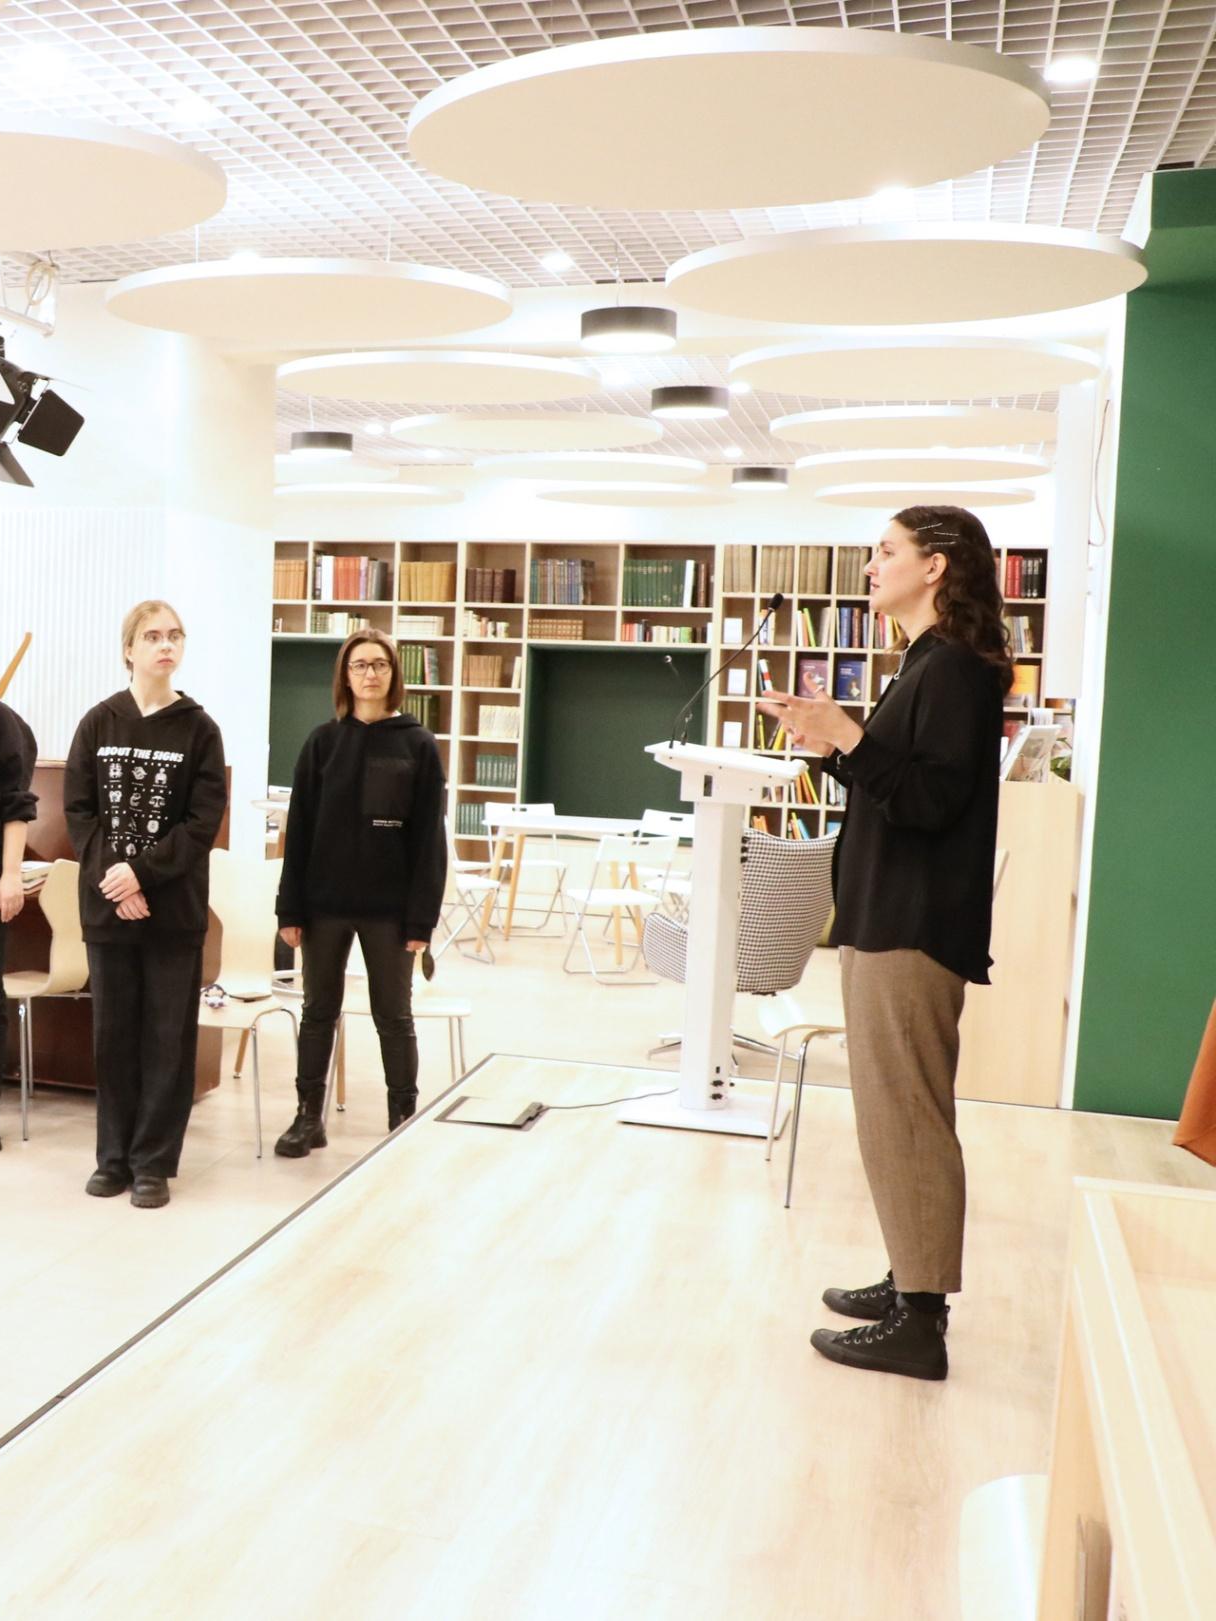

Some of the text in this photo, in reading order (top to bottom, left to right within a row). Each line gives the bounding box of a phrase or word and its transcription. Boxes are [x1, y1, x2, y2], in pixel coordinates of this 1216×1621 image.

[97, 746, 132, 756] ABOUT
[133, 748, 152, 759] THE
[152, 750, 184, 763] SIGNS
